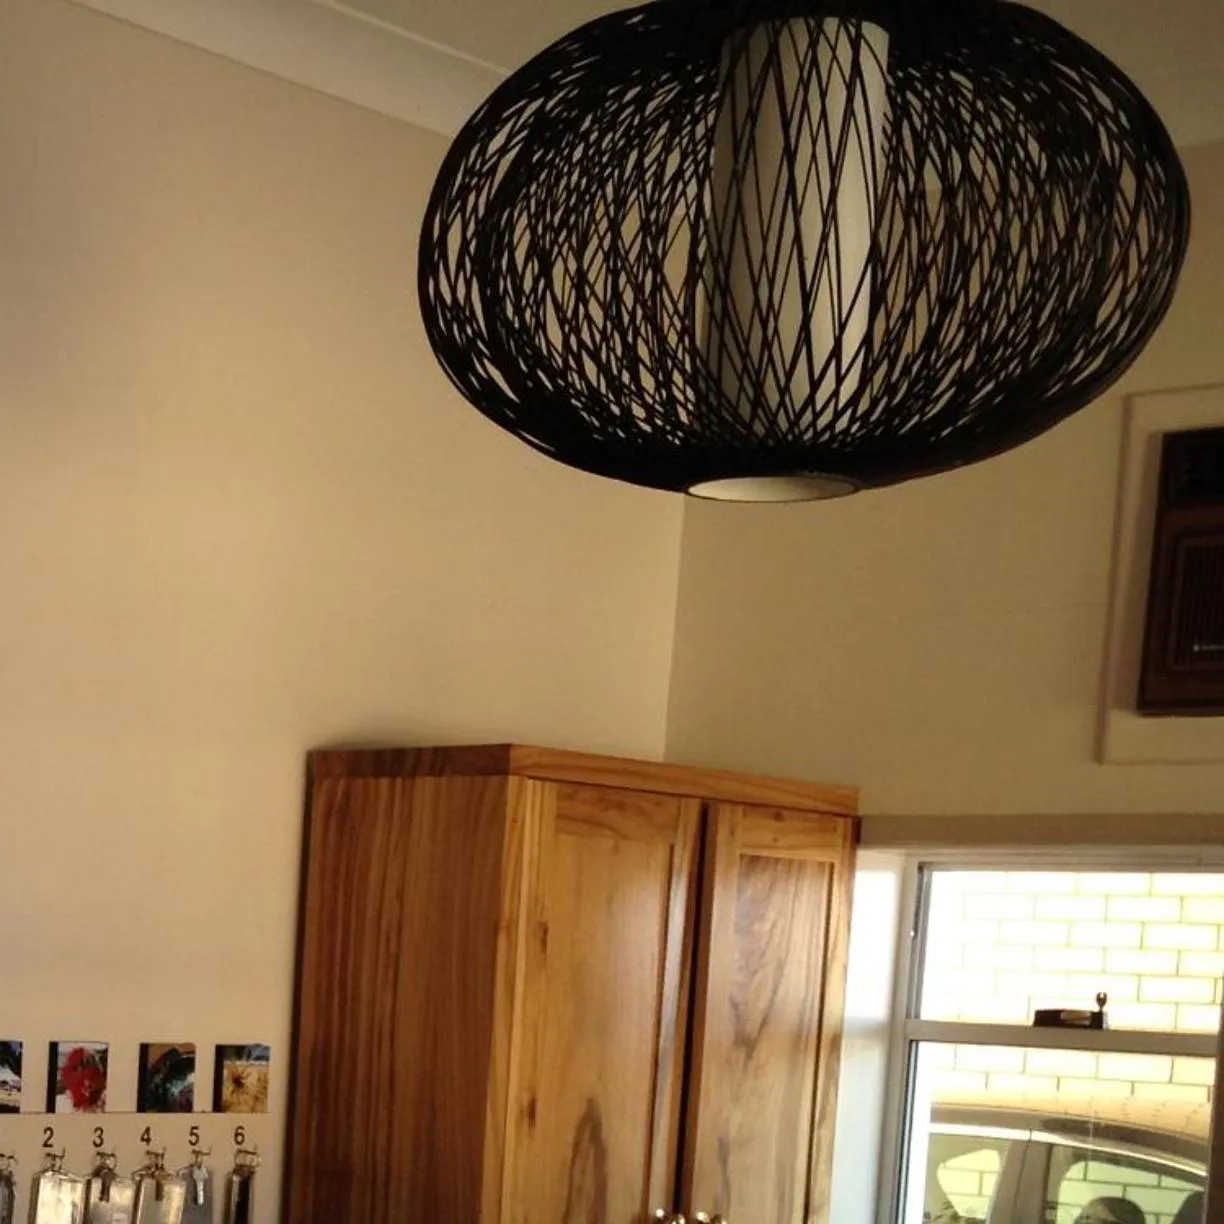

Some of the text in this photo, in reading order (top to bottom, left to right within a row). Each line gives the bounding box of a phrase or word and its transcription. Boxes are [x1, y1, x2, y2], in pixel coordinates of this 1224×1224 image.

[42, 1126, 54, 1148] 2
[92, 1126, 104, 1148] 3
[140, 1126, 152, 1146] 4
[188, 1125, 200, 1147] 5
[233, 1125, 245, 1146] 6
